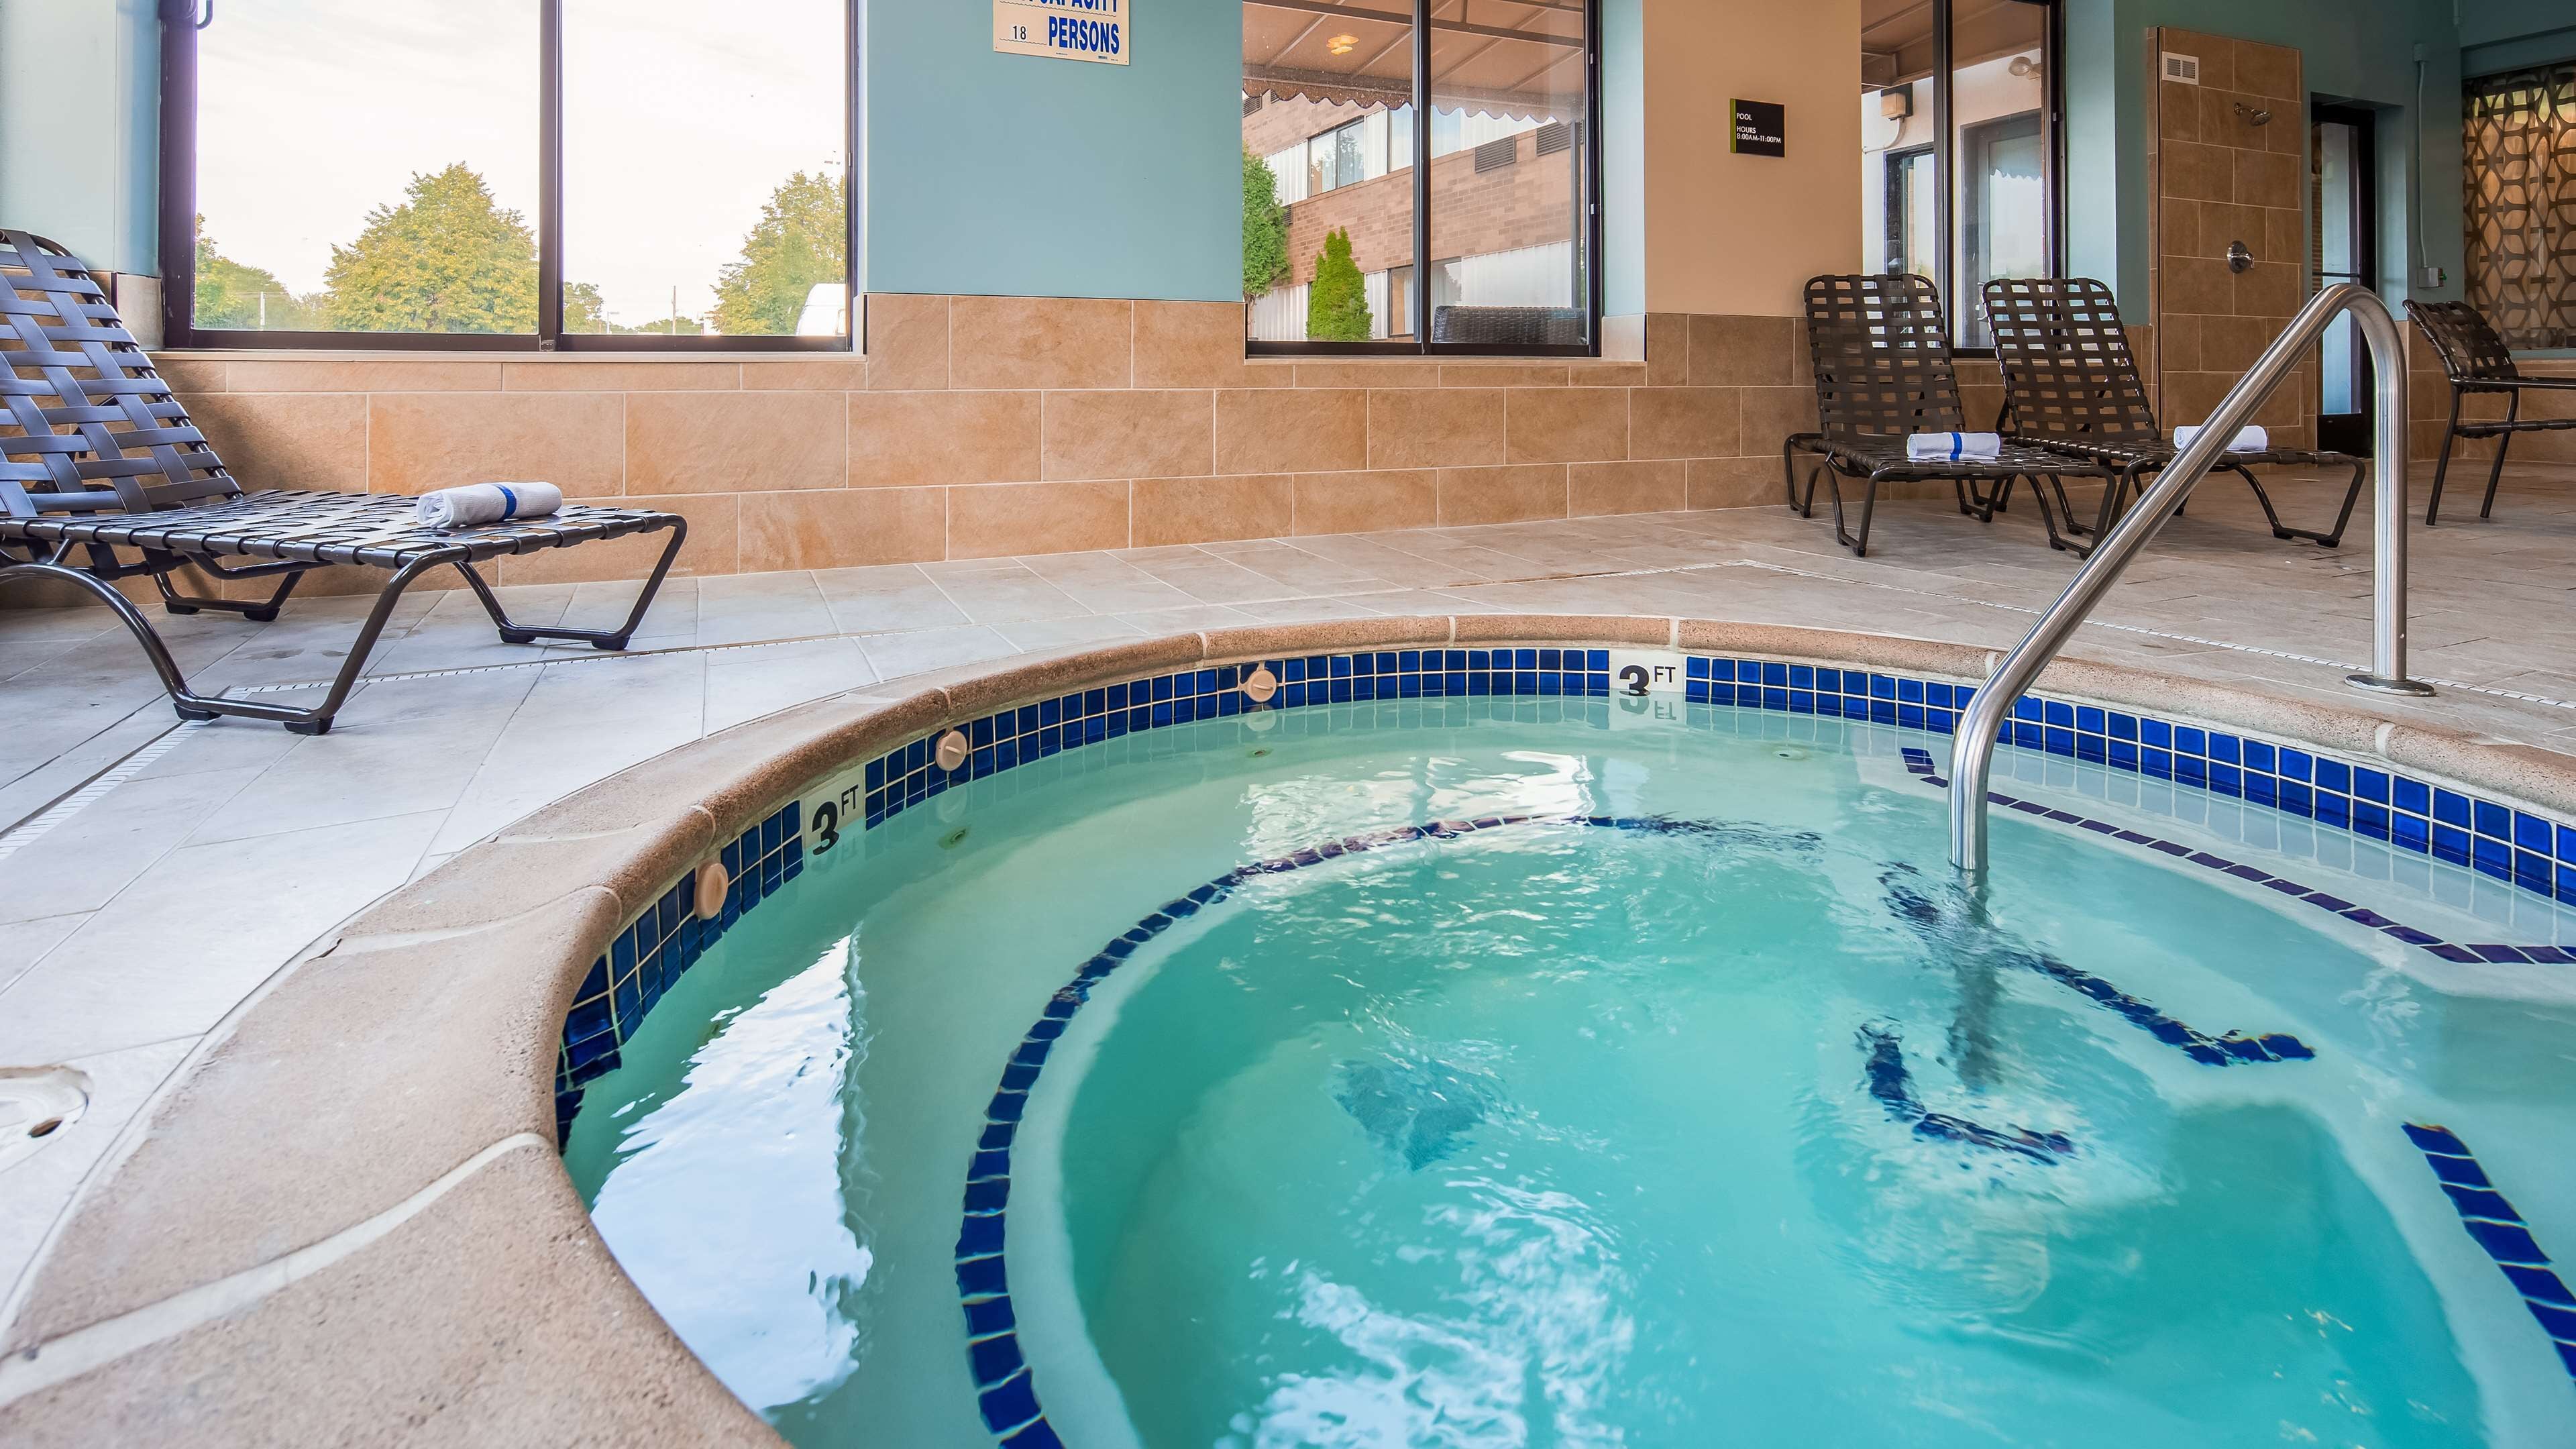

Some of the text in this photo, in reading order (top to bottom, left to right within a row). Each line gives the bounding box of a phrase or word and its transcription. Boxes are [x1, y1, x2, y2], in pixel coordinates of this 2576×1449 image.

[1013, 16, 1120, 54] 18 PERSONS
[1736, 125, 1756, 133] HOURS
[1619, 665, 1676, 696] 3 FT
[812, 801, 840, 855] 3
[841, 784, 859, 816] FT
